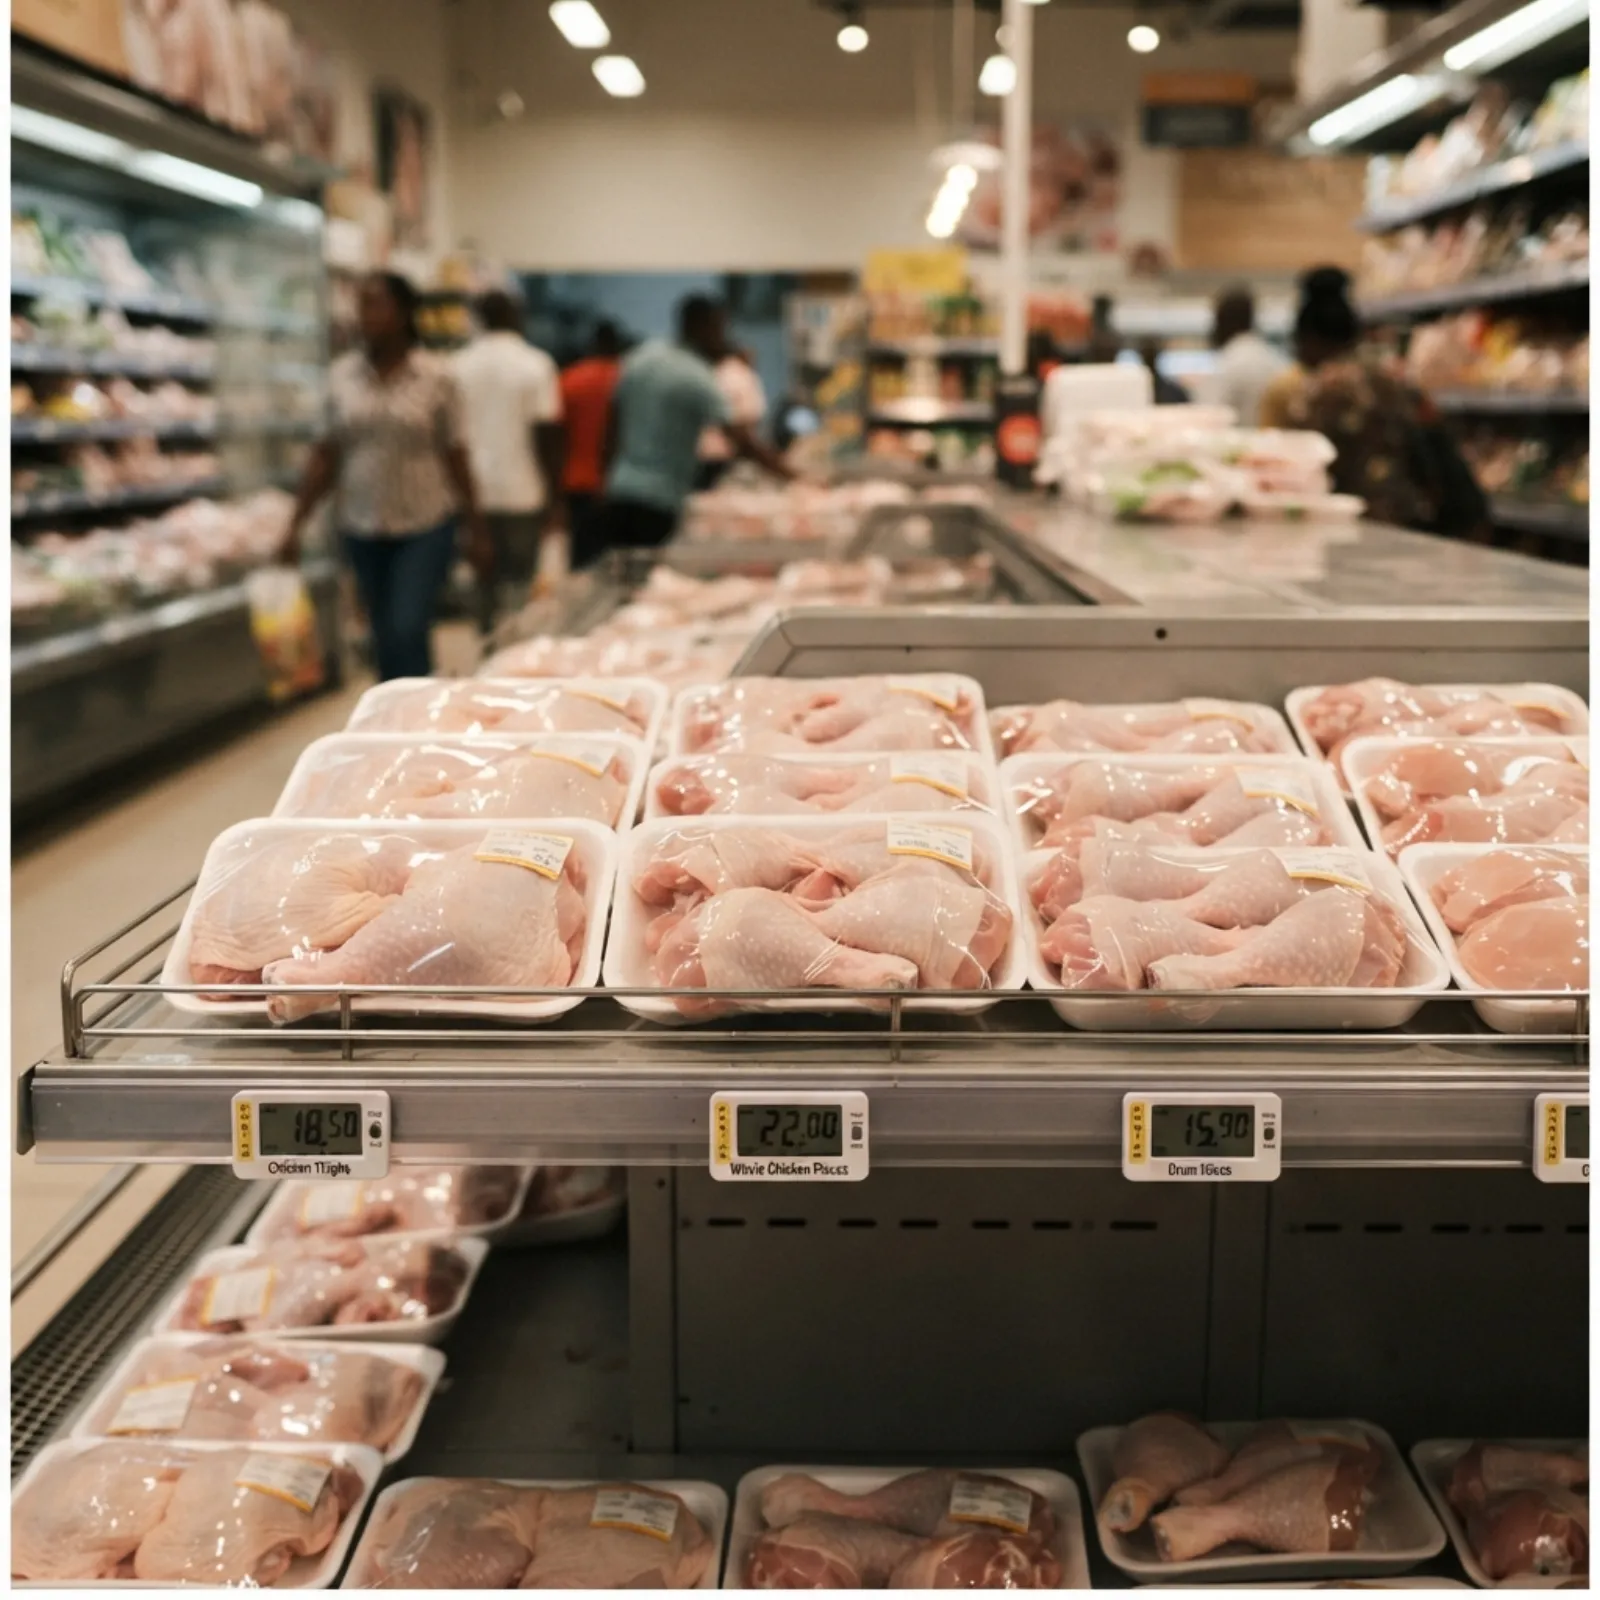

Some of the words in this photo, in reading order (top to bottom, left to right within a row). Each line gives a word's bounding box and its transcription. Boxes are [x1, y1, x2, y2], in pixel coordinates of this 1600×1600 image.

[294, 1108, 358, 1147] 18.50
[759, 1110, 838, 1148] 22.00
[767, 1160, 811, 1176] Chicken
[1168, 1162, 1198, 1176] Drum
